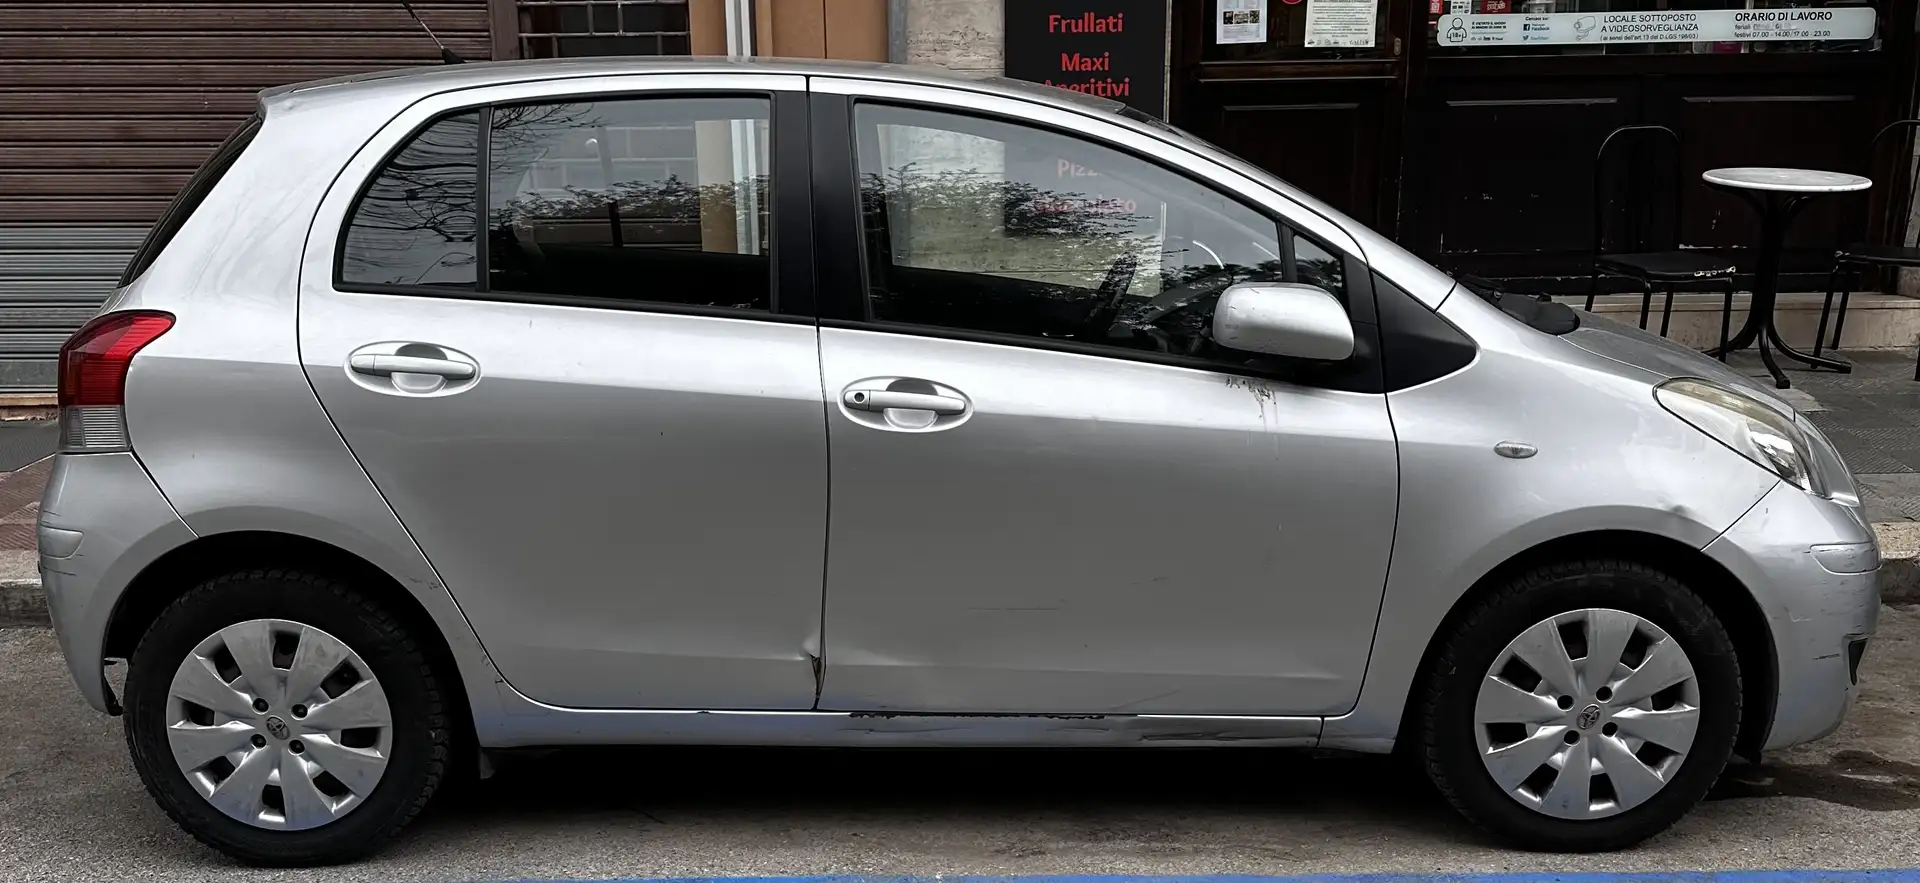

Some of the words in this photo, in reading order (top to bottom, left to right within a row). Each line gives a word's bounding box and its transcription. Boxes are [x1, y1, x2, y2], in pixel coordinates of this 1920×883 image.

[1603, 15, 1636, 23] LOCALE
[1639, 14, 1697, 22] SOTTOPOSTO
[1734, 12, 1776, 21] ORARIO
[1777, 12, 1788, 21] DI
[1790, 11, 1833, 21] LAVORO
[1048, 12, 1124, 33] Frullati
[1601, 25, 1607, 33] A
[1608, 23, 1699, 33] VIDEOSORVEGLIANZA
[1061, 51, 1110, 72] Maxi
